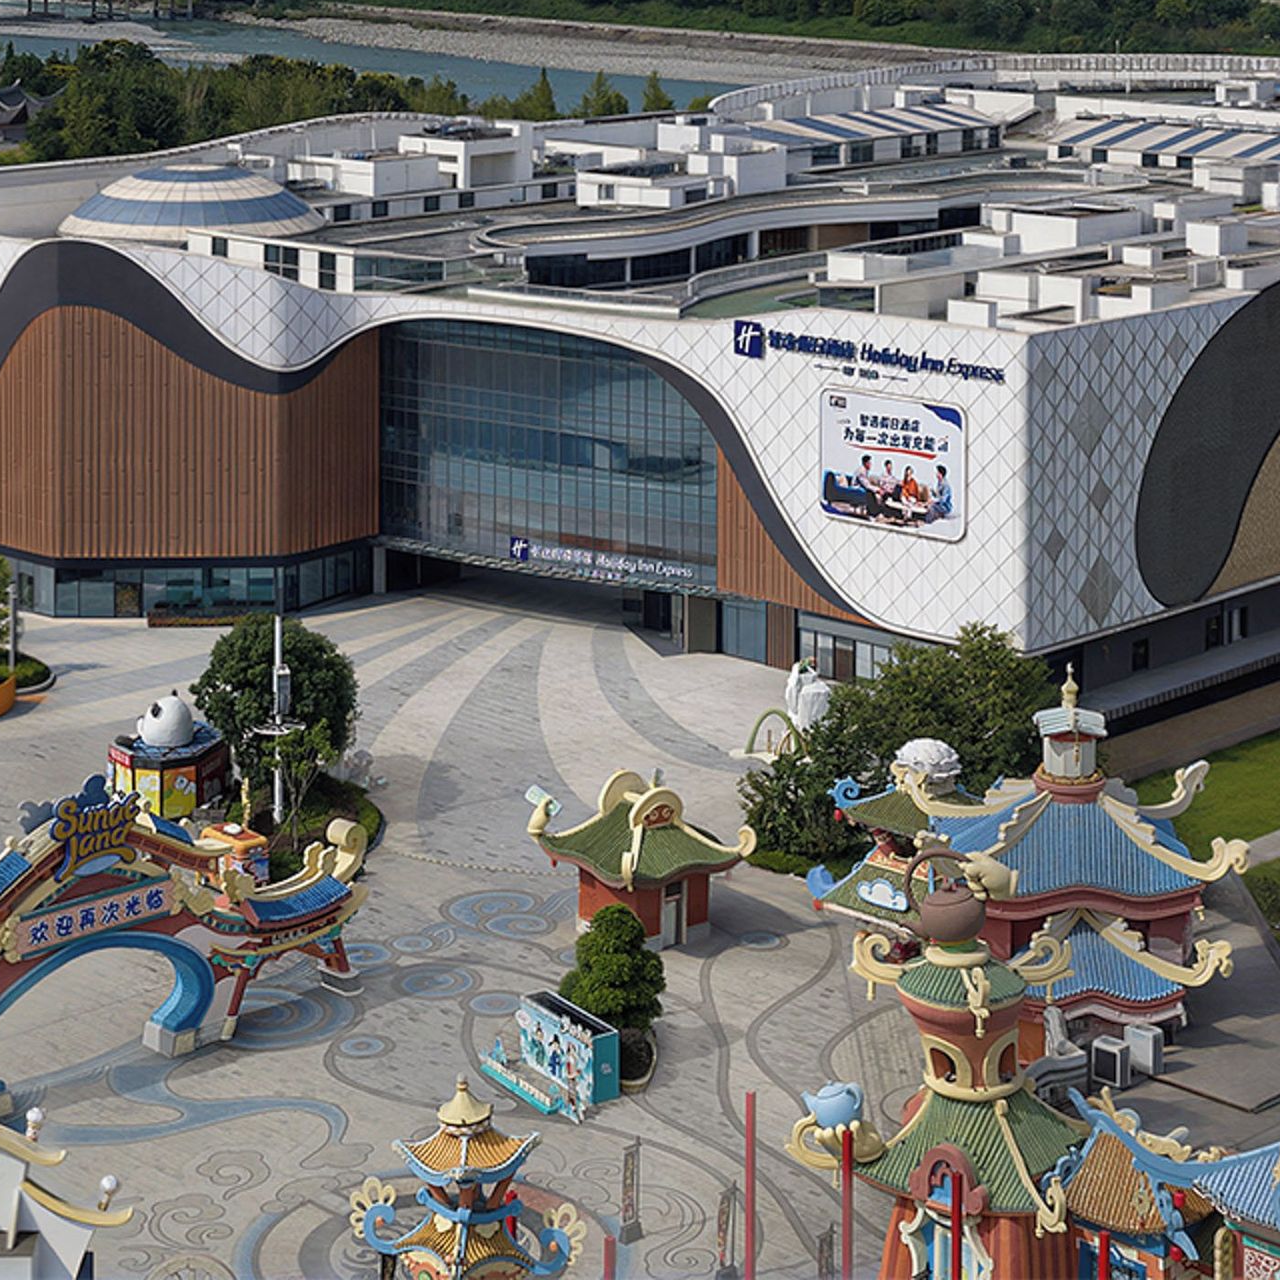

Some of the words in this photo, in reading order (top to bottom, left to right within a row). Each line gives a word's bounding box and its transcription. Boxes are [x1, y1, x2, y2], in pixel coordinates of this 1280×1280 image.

[860, 342, 919, 373] Holiday
[920, 351, 945, 372] Inn
[947, 358, 1006, 384] Express
[595, 553, 637, 573] Holiday
[637, 559, 655, 572] Inn
[655, 562, 693, 578] Express
[29, 887, 164, 944] 欢迎再次光临
